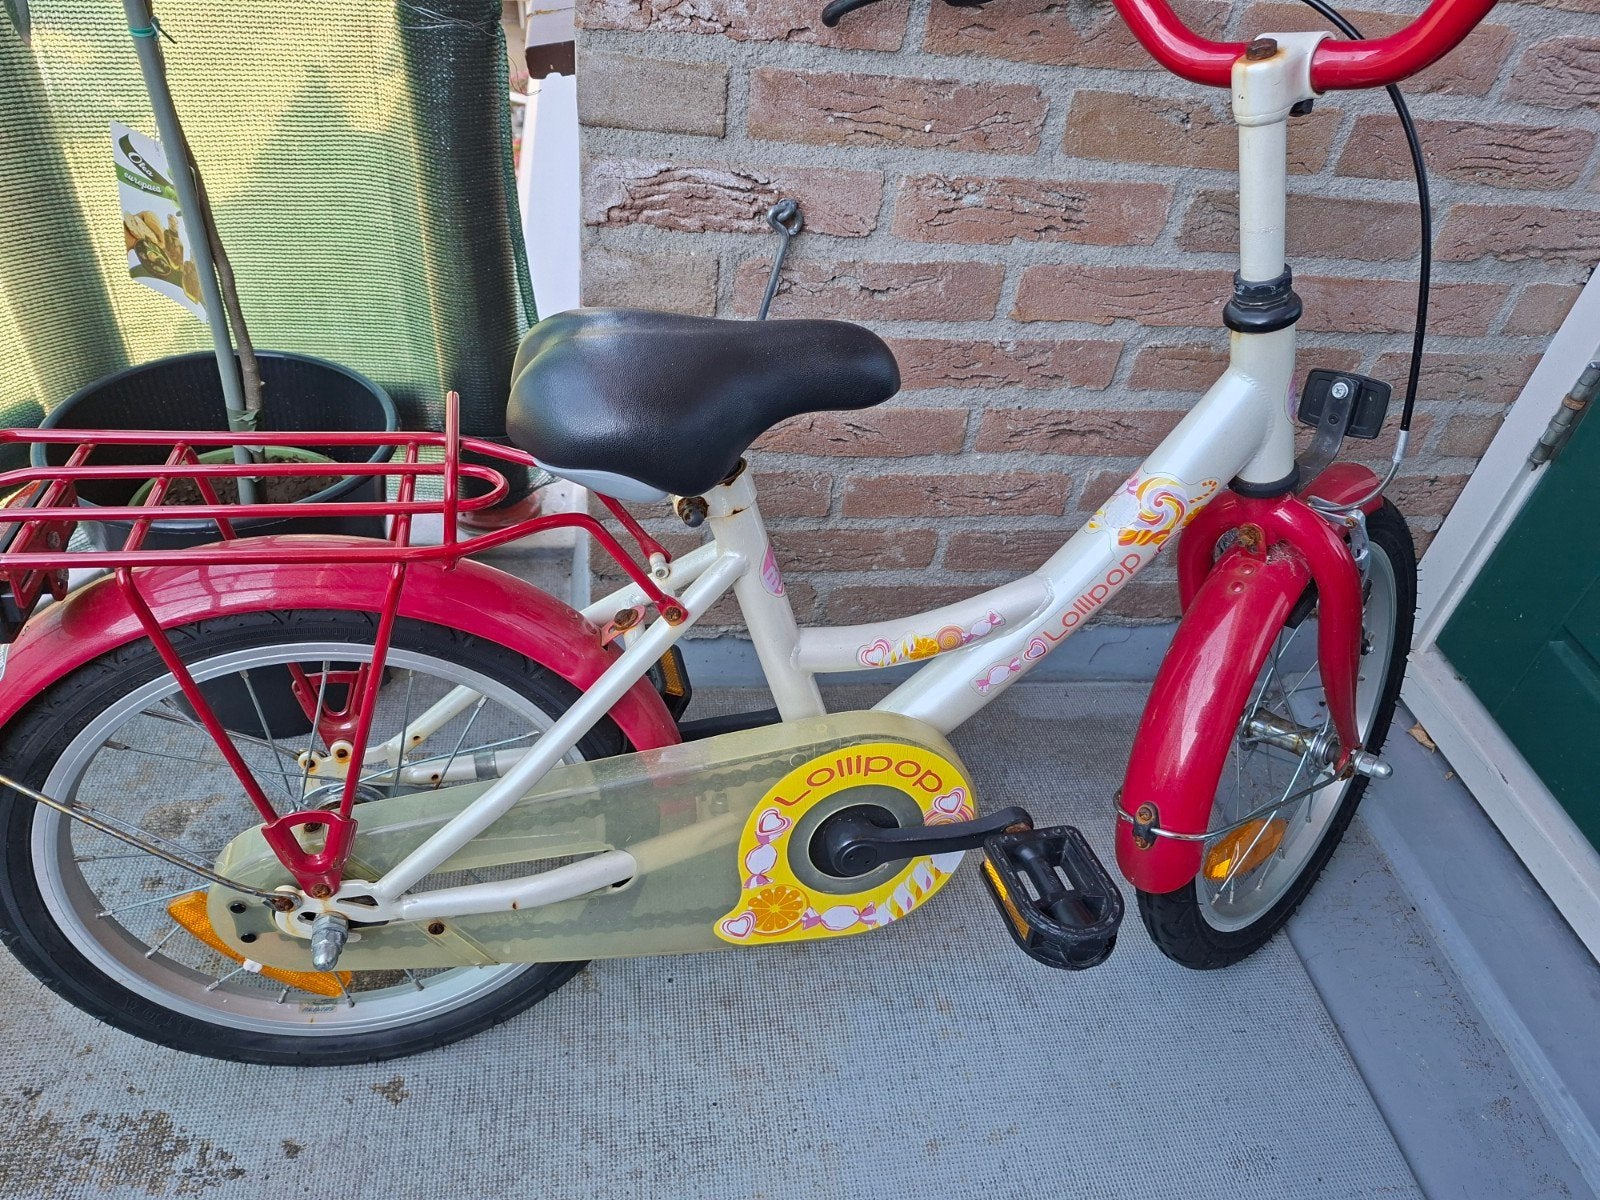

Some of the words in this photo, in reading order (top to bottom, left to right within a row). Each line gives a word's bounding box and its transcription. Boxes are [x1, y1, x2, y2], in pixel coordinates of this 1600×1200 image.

[128, 151, 153, 177] Olea
[1042, 553, 1141, 641] Lollipop
[773, 755, 943, 807] Lollipop
